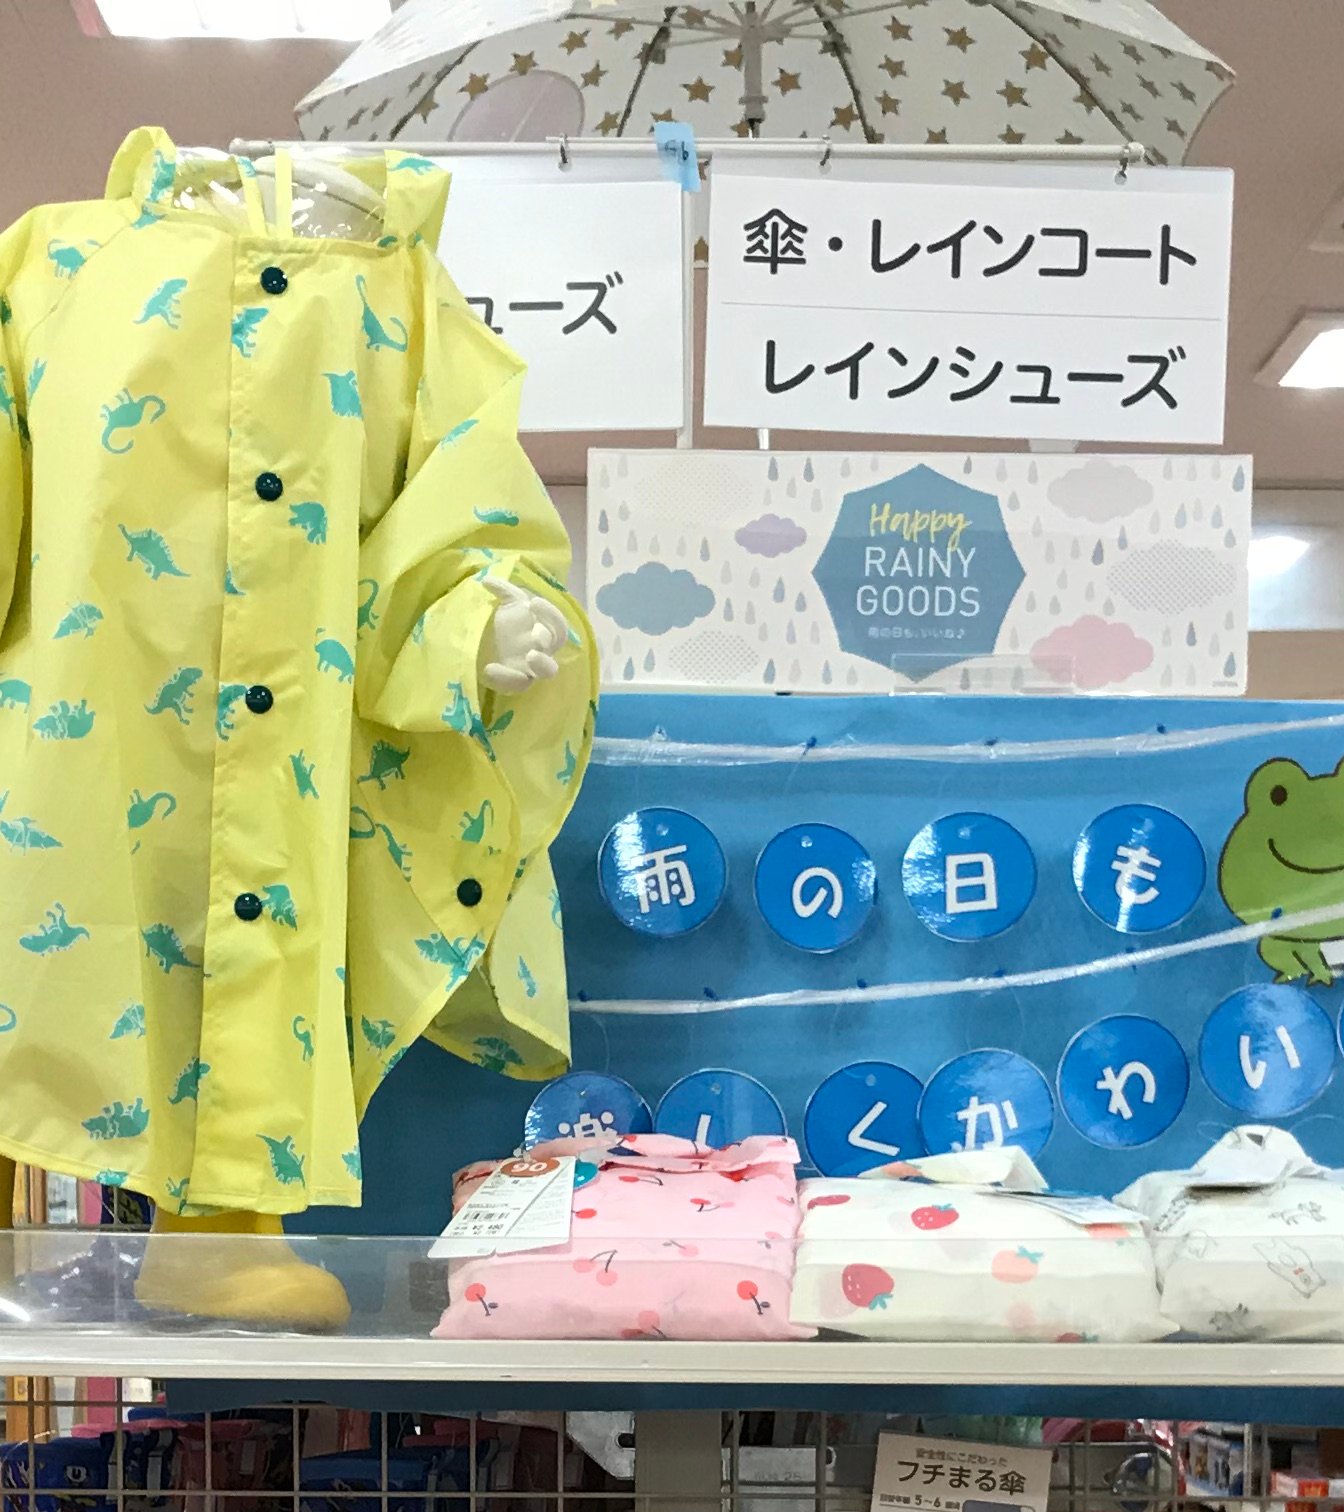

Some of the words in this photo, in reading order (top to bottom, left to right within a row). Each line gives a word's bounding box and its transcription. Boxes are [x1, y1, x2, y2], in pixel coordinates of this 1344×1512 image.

[742, 207, 1198, 287] 傘・レインコート
[763, 339, 1188, 412] レインシューズ
[869, 502, 973, 552] Happy
[864, 546, 976, 578] RAINY
[856, 585, 981, 617] GOODS
[511, 1162, 548, 1173] 90
[897, 1460, 1027, 1496] フチまる傘
